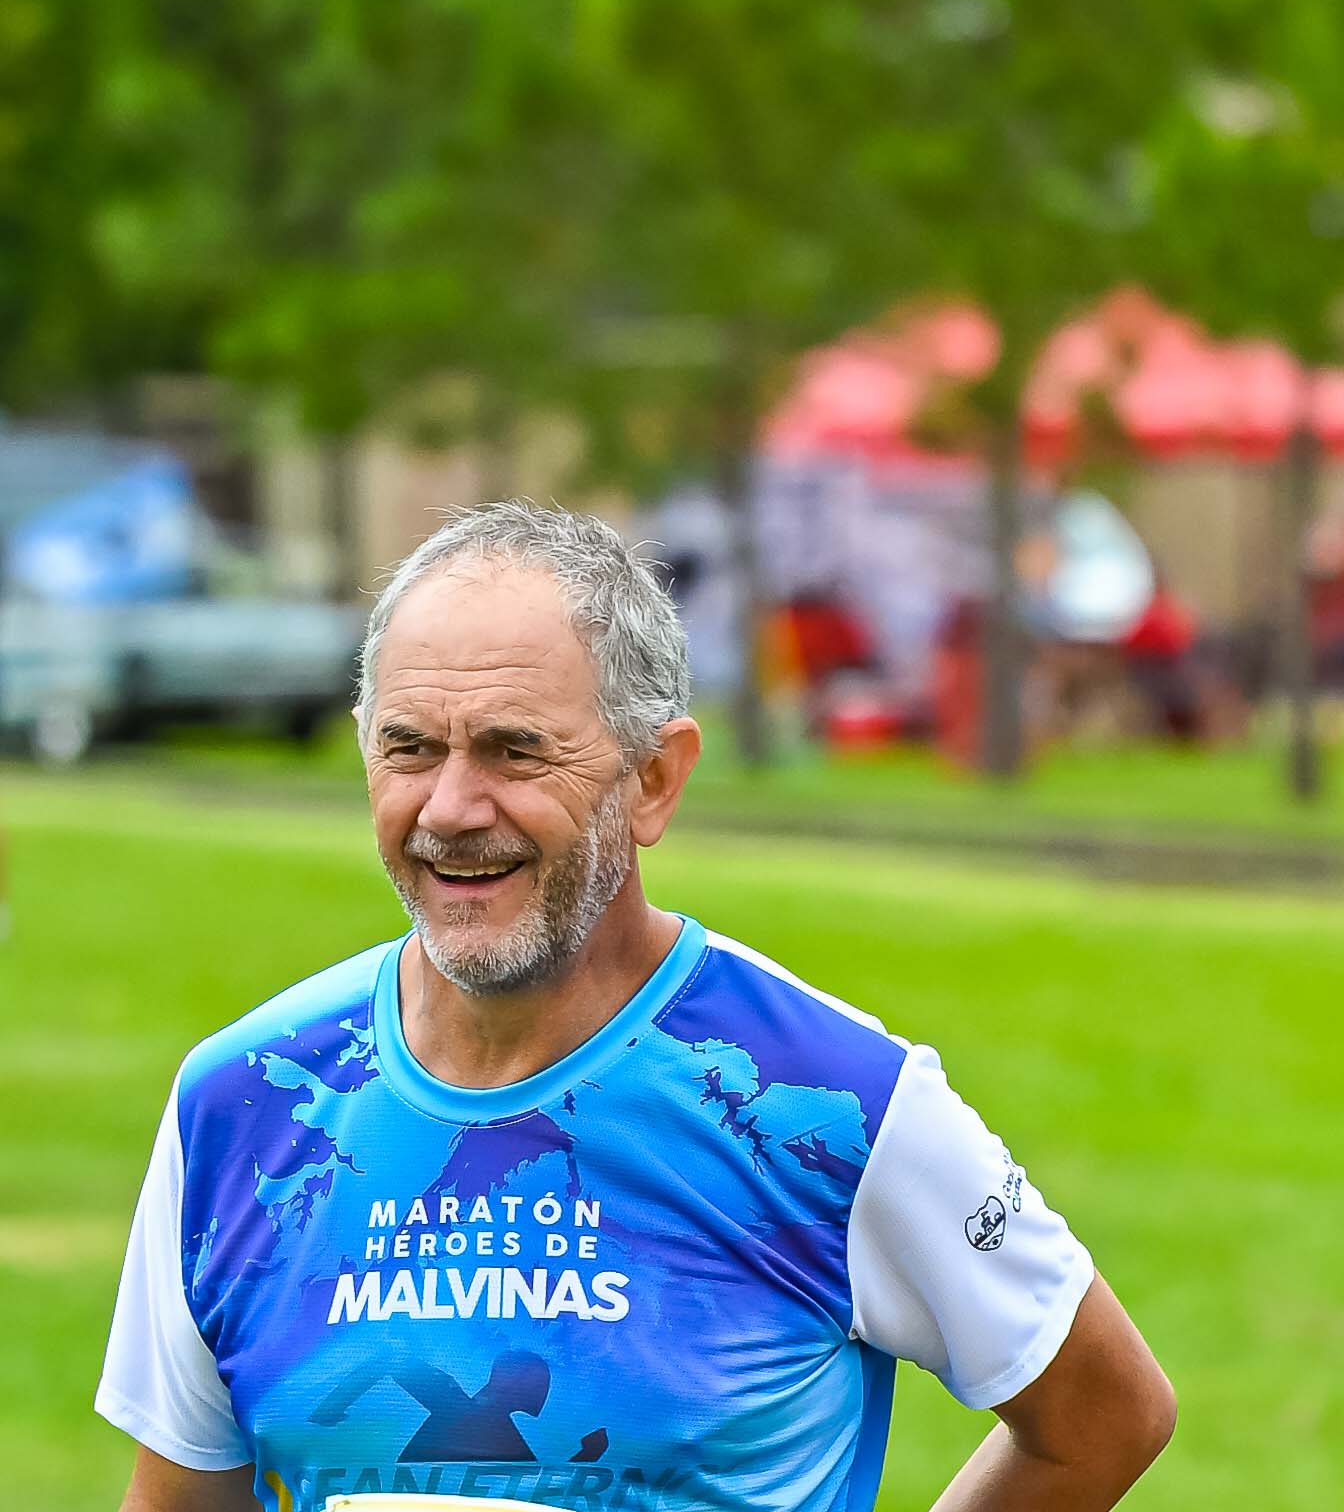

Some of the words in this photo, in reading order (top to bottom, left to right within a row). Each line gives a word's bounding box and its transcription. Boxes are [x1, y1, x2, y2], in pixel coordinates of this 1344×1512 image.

[367, 1191, 601, 1229] MARATÓN
[364, 1229, 521, 1260] HÉROES
[545, 1235, 598, 1259] DE
[326, 1266, 631, 1325] MALVINAS
